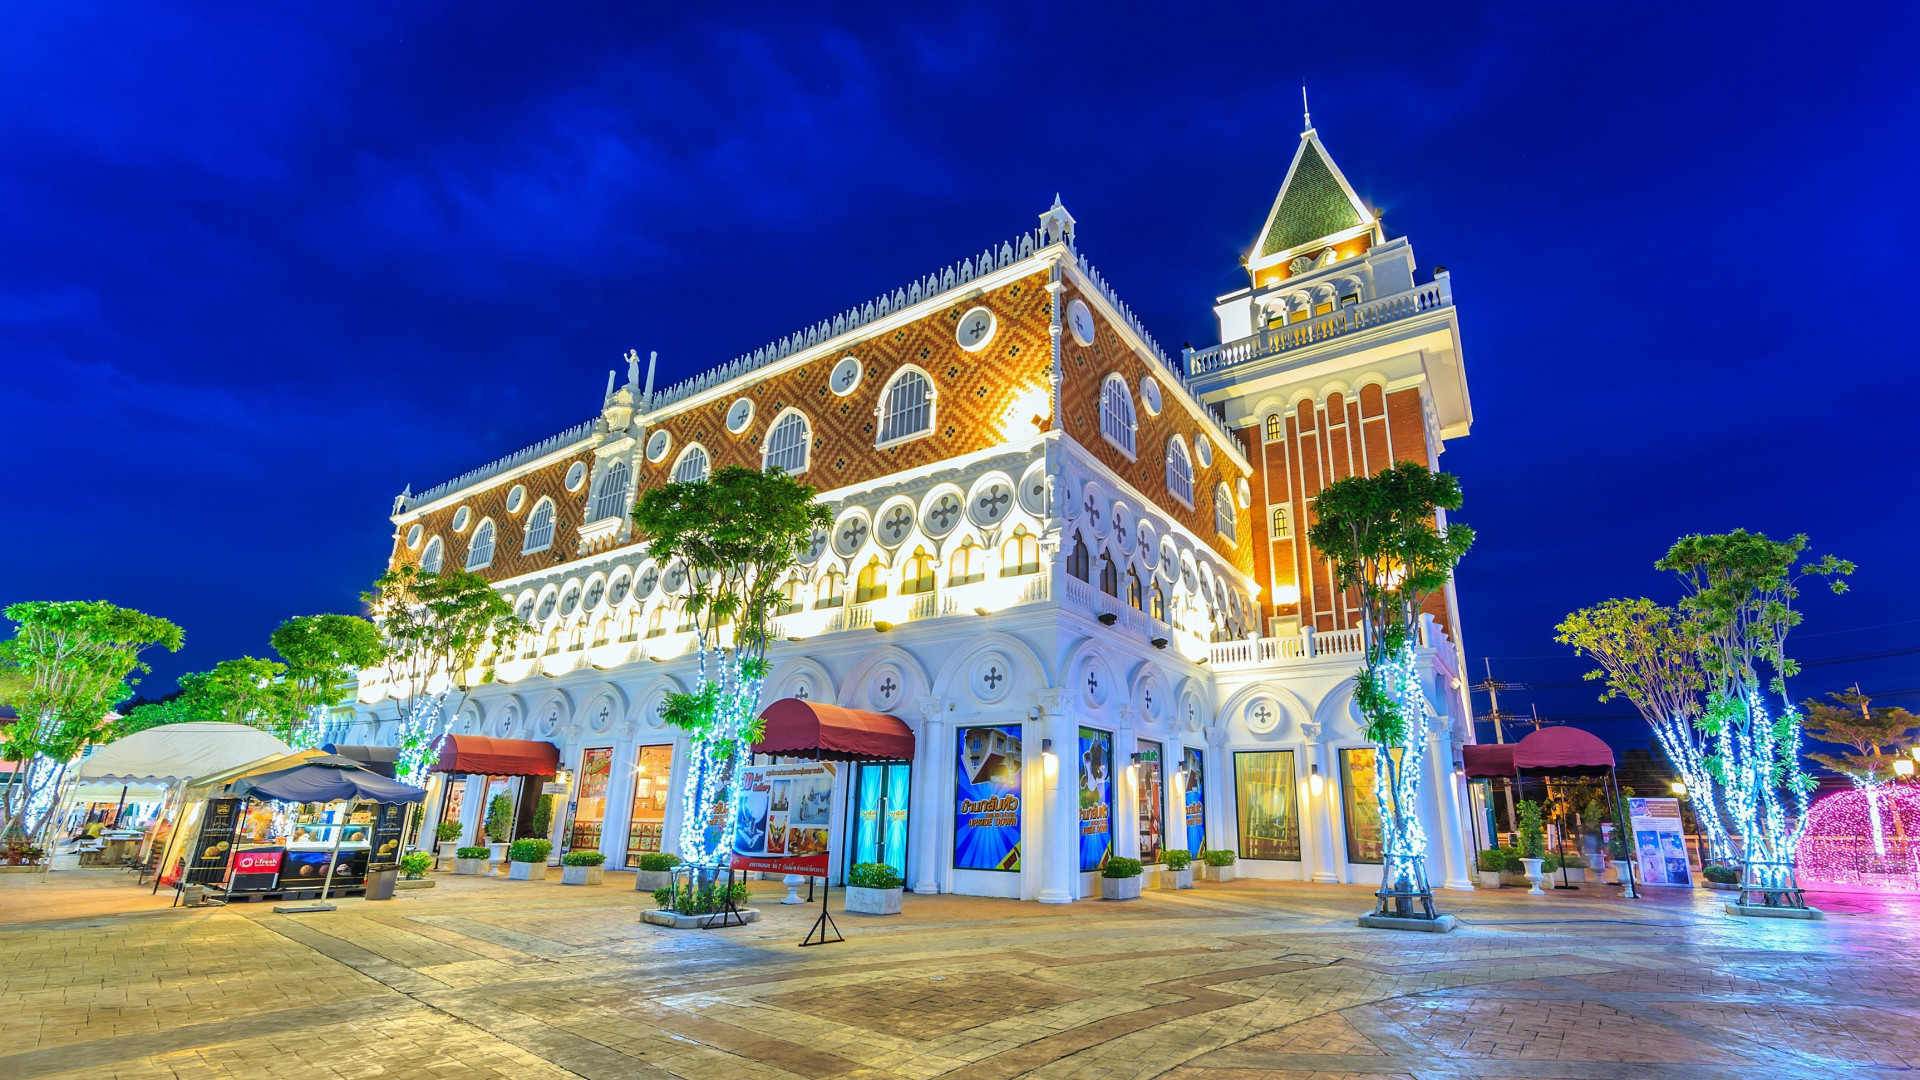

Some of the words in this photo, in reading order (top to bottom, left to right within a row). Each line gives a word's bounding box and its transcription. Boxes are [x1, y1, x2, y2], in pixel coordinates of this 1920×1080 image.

[741, 772, 754, 791] 3D
[961, 794, 1019, 813] บ้านกลับหัว
[968, 817, 993, 827] UPSIDE
[995, 816, 1017, 826] DOWN
